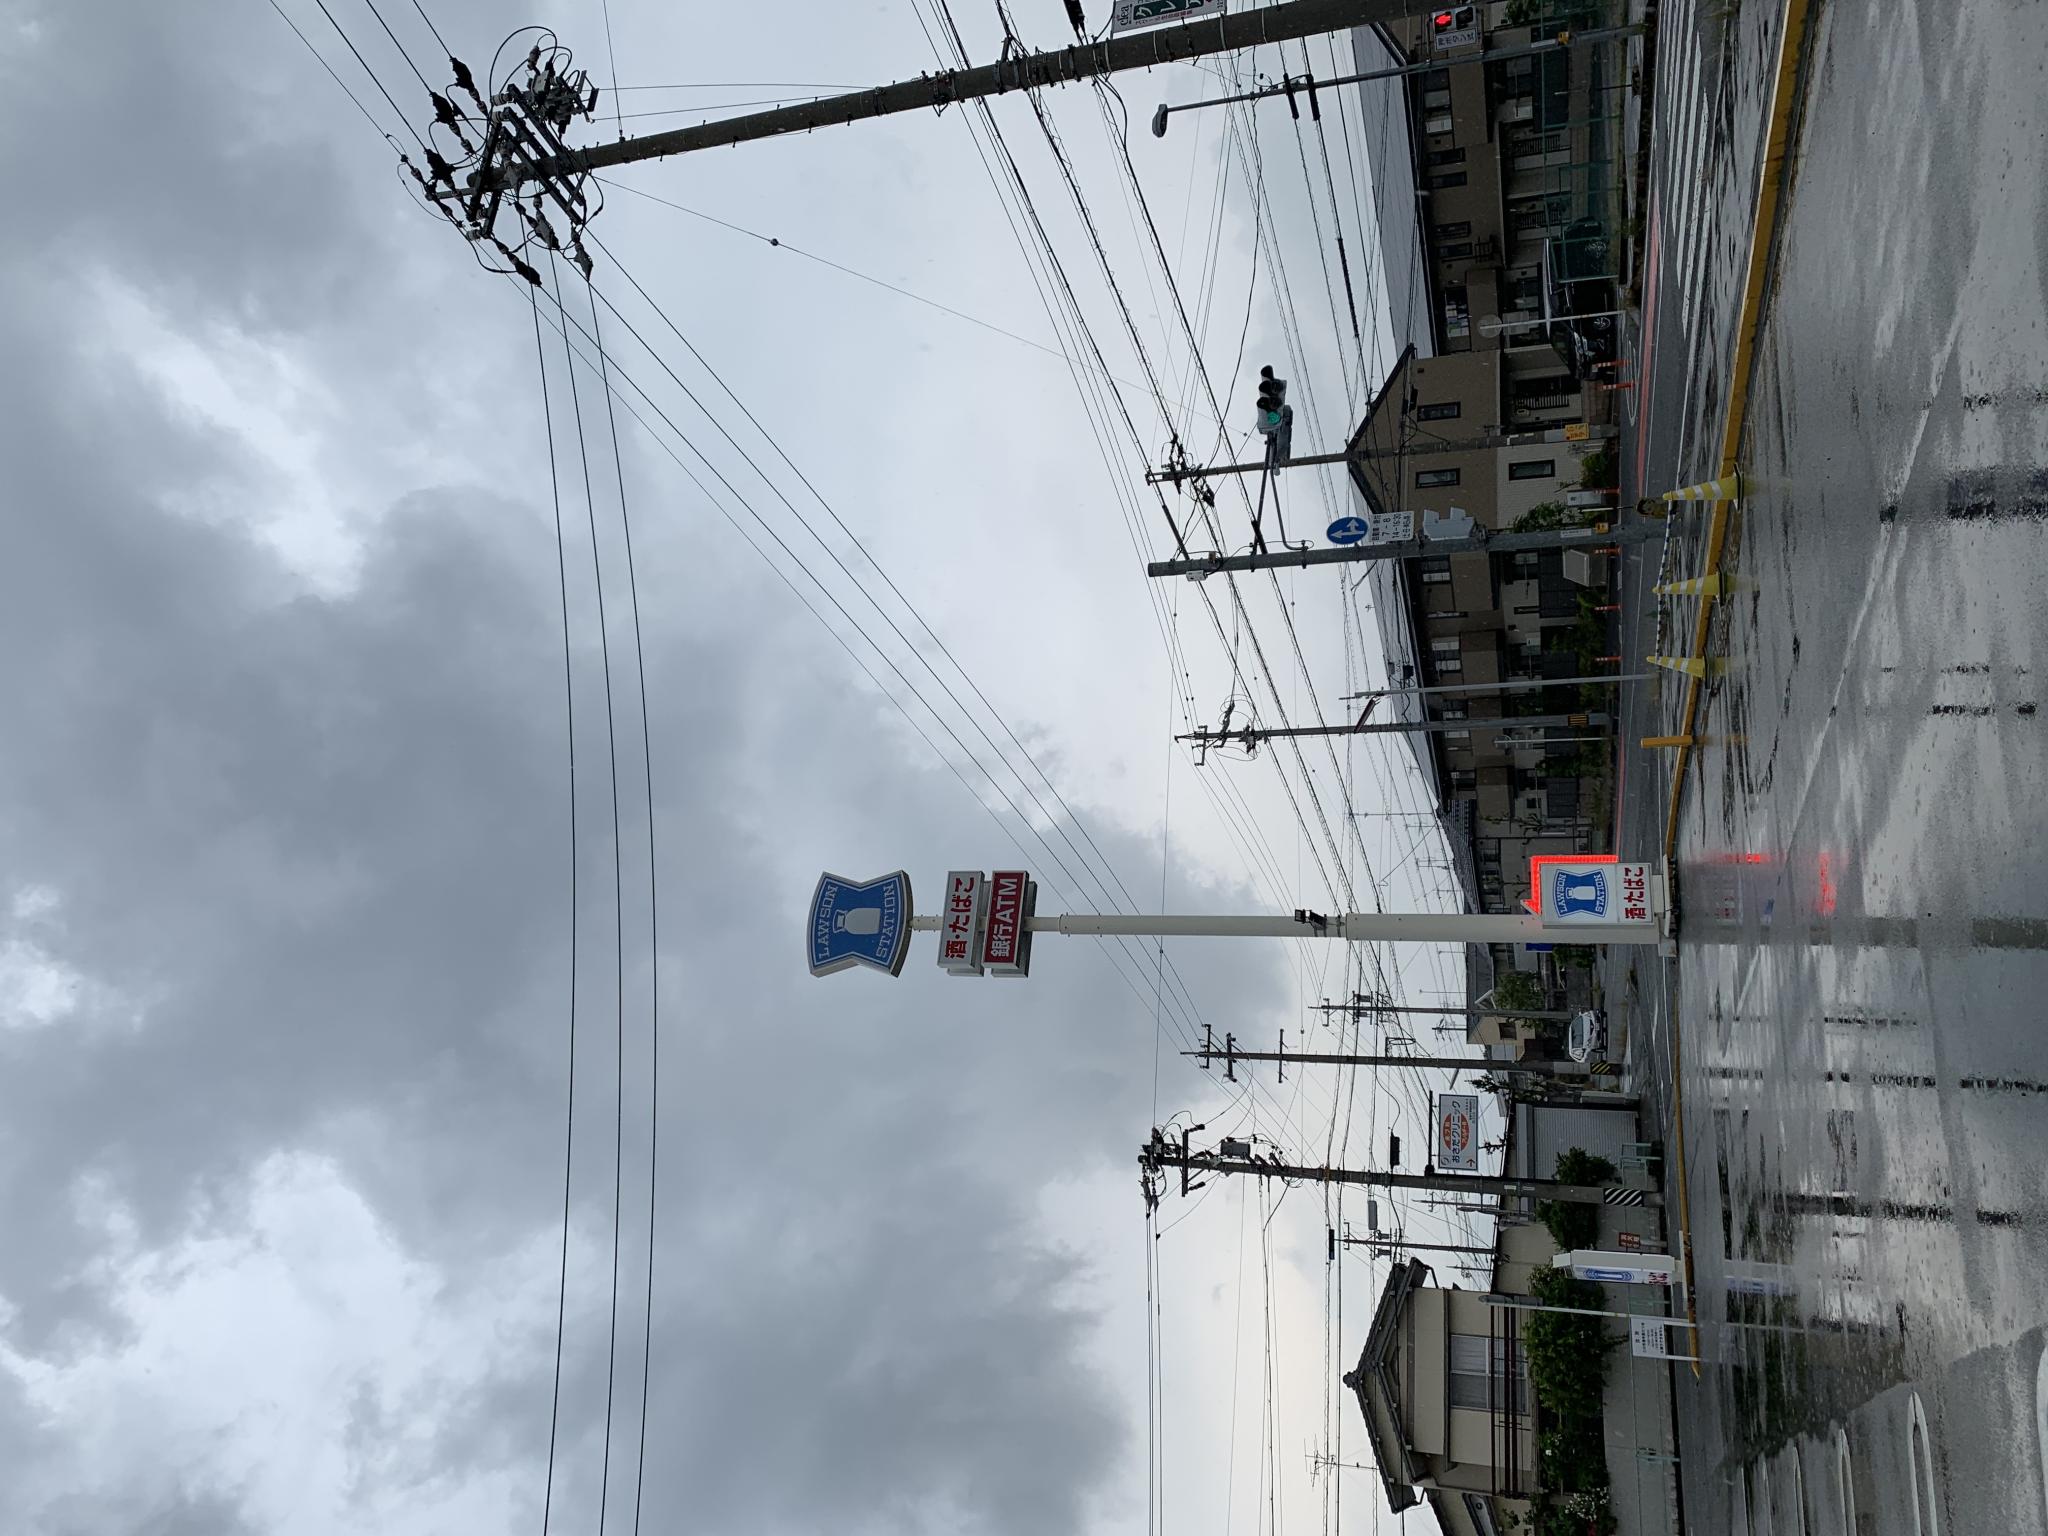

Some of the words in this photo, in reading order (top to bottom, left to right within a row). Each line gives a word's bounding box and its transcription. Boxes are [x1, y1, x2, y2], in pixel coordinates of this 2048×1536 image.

[817, 885, 839, 958] LAWSON
[875, 884, 896, 957] STATION
[944, 877, 976, 959] 酒・たばこ
[990, 878, 1018, 957] 銀行ATM
[1556, 874, 1568, 912] LAWSON
[1593, 874, 1605, 912] STATION
[1624, 867, 1646, 919] 酒・たばこ
[1452, 1100, 1461, 1163] おさだクリニック
